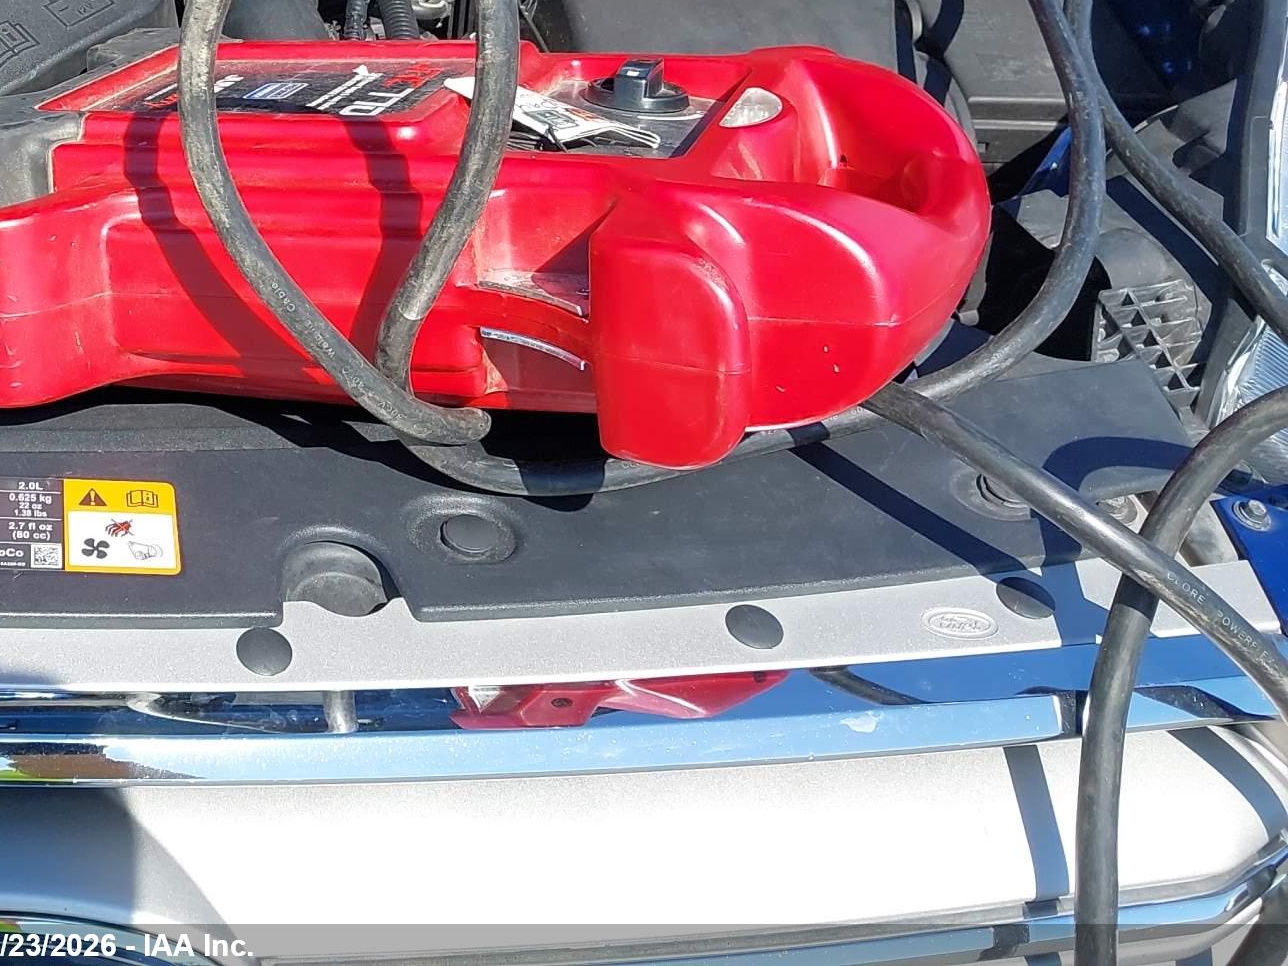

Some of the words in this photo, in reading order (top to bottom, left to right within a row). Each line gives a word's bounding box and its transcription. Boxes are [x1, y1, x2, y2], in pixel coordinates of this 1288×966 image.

[18, 481, 44, 490] 2.0L
[8, 493, 37, 502] 0.625
[39, 493, 52, 505] kg
[8, 521, 25, 530] 2.7
[28, 522, 36, 530] fl
[38, 523, 53, 531] oz
[32, 531, 51, 541] cc)
